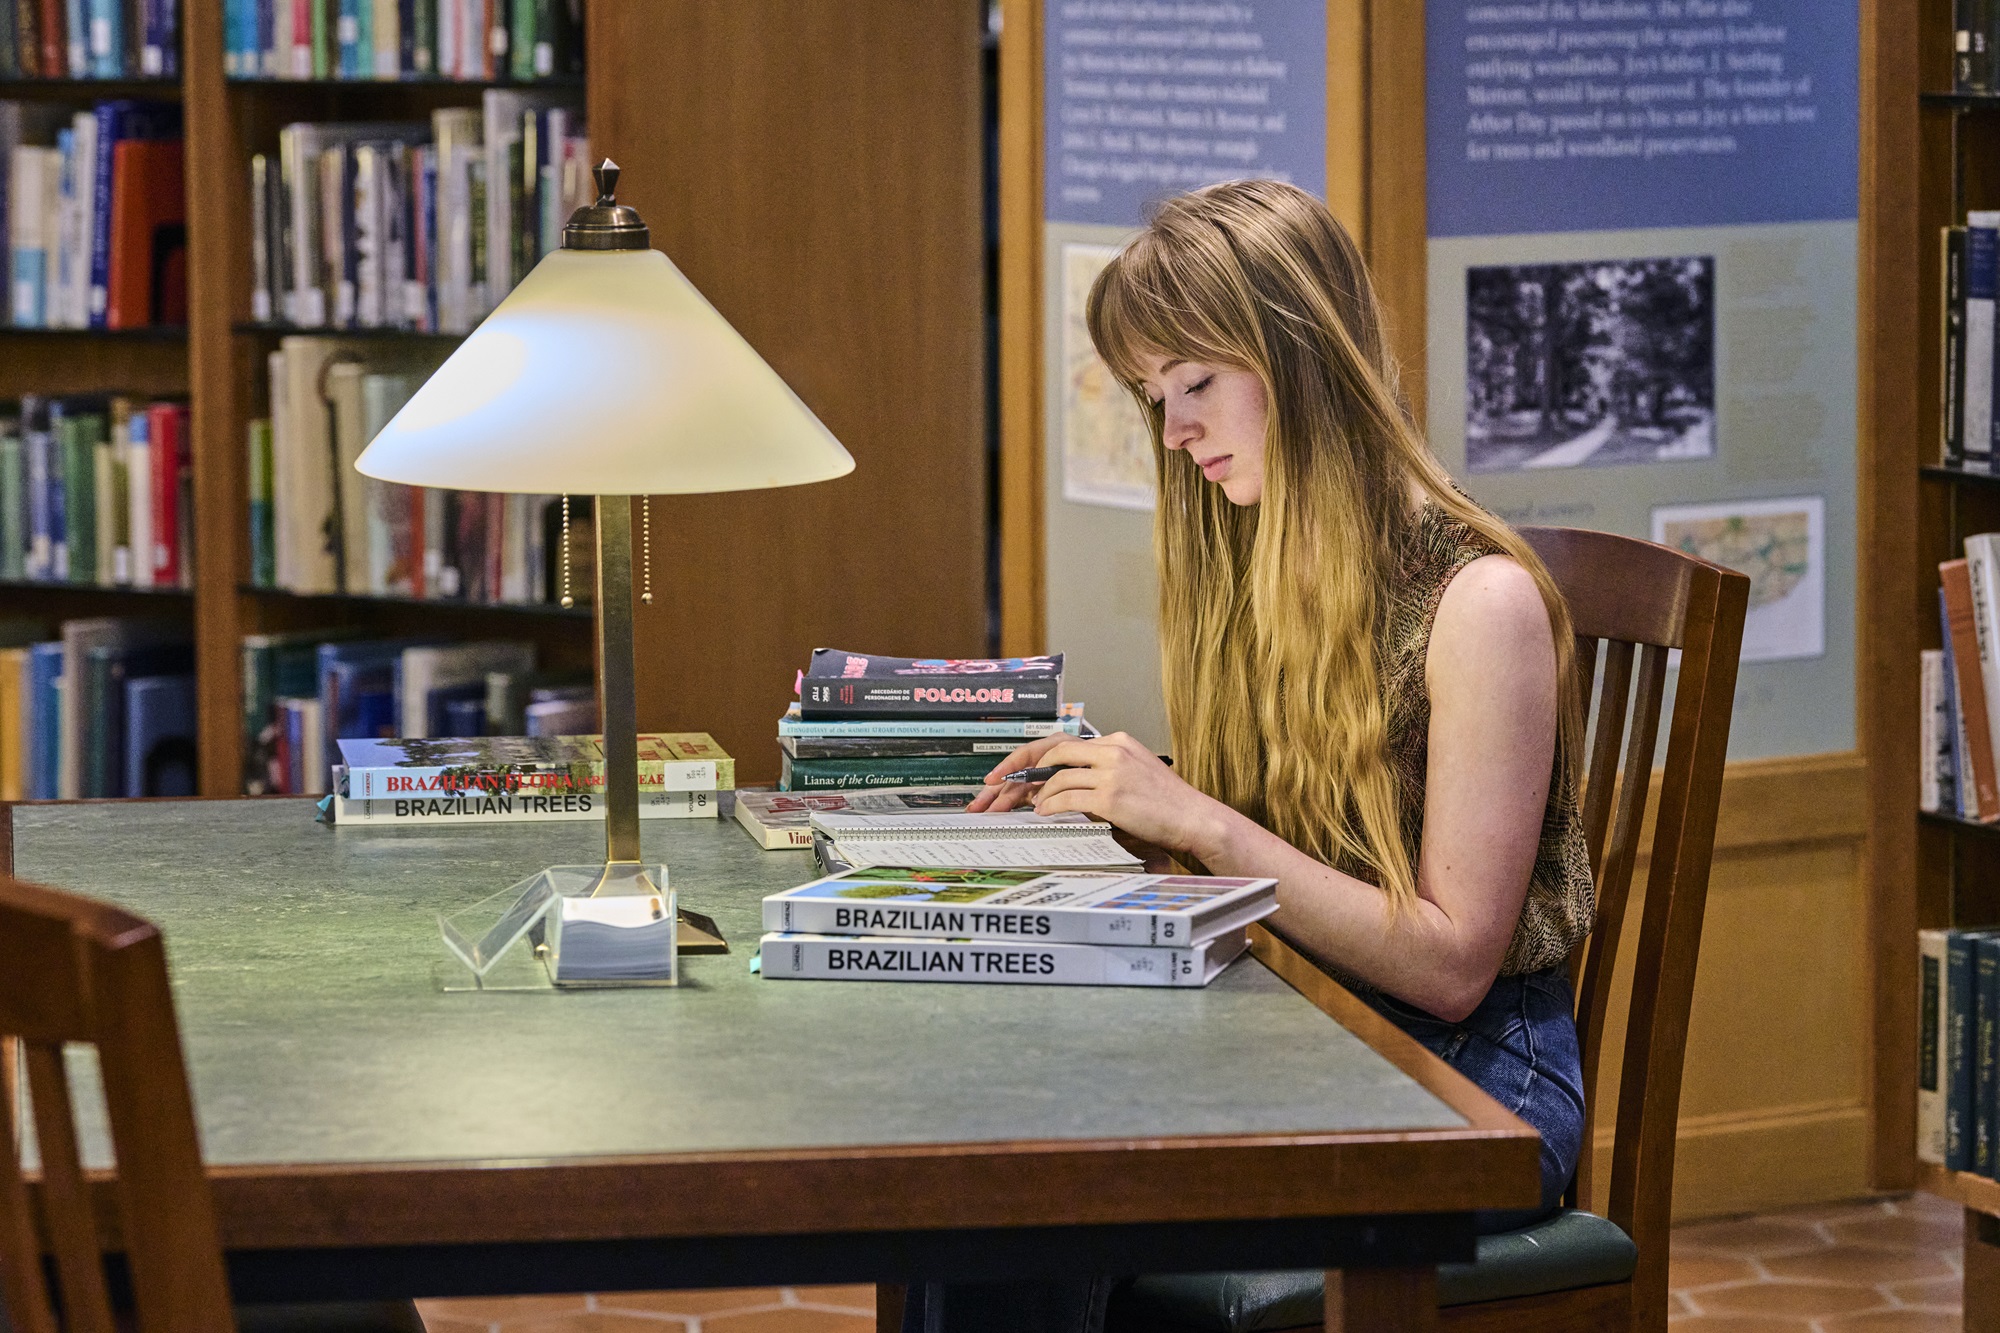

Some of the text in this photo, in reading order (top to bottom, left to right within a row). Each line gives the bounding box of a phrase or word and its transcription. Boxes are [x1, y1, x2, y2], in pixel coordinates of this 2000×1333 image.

[913, 687, 1015, 703] FOLCLORE
[836, 726, 845, 734] the
[928, 726, 945, 734] Brazil
[386, 774, 498, 792] BRAZILIAN
[505, 773, 573, 790] FLORA
[804, 775, 835, 785] Lianas
[837, 774, 848, 788] of
[849, 774, 863, 785] the
[865, 774, 904, 785] Guianas
[395, 795, 592, 817] BRAZILIAN TREES
[697, 793, 707, 807] 02
[788, 832, 812, 845] Vine
[836, 908, 1051, 936] BRAZILIAN TREES
[1163, 921, 1175, 938] 03
[828, 949, 1055, 975] BRAZILIAN TREES
[1182, 959, 1192, 975] 01
